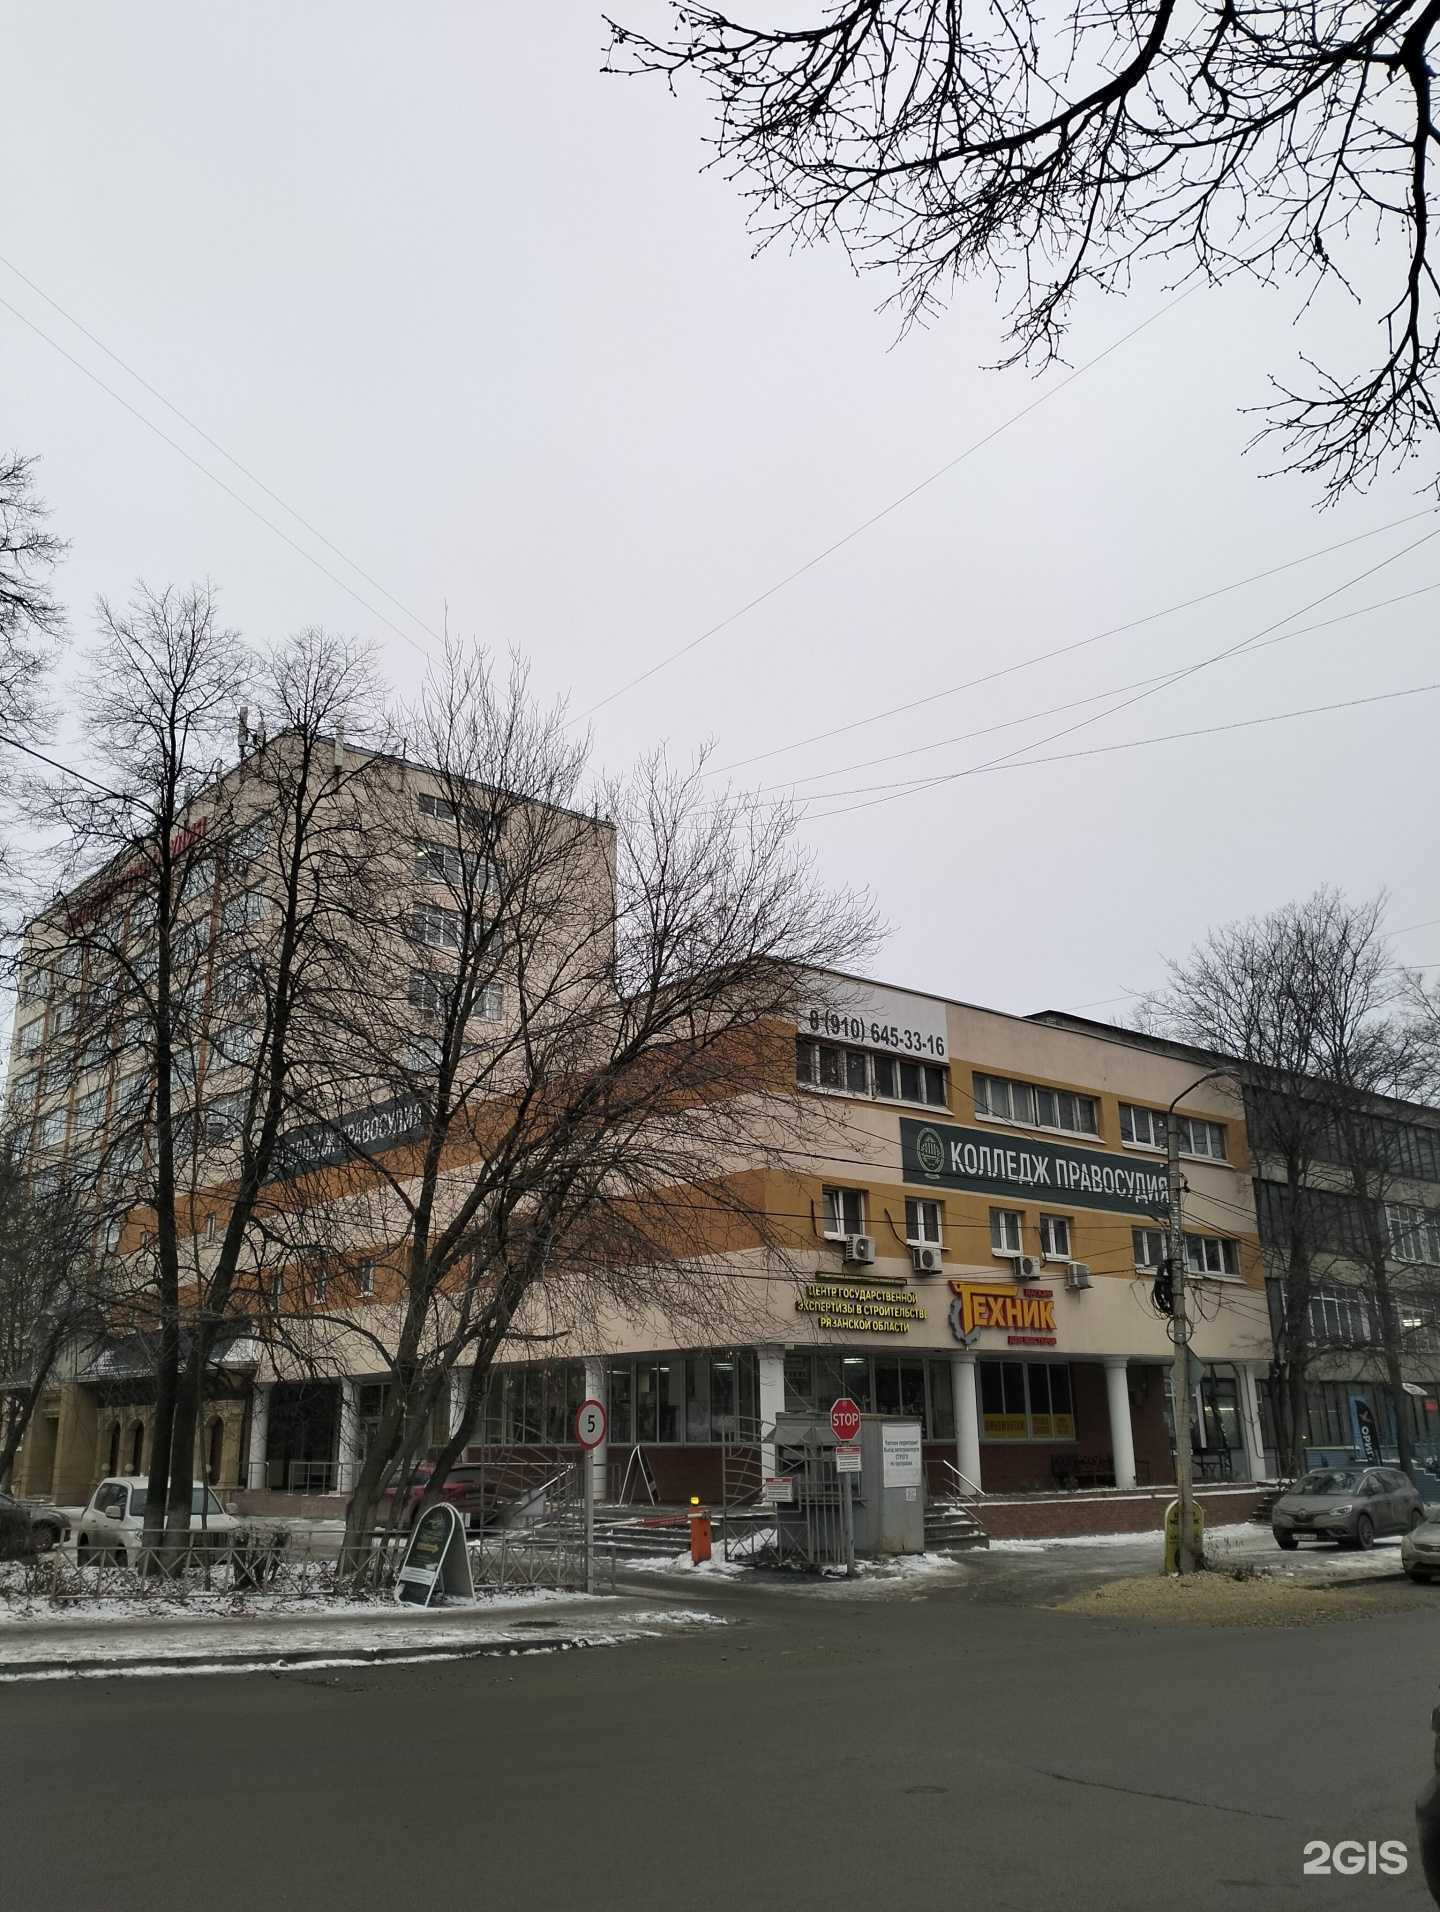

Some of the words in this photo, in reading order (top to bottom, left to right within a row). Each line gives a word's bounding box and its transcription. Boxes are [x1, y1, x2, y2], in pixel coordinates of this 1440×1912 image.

[809, 1009, 819, 1032] 8
[825, 1009, 865, 1042] (910)
[870, 1023, 945, 1057] 645-33-16
[950, 1141, 1051, 1187] КОЛЛЕДЖ
[1055, 1158, 1170, 1204] ПРАВОСУДИЯ
[808, 1285, 837, 1298] ЦЕНТР
[838, 1287, 917, 1304] ГОСУДАРСТВЕННОЙ
[798, 1301, 855, 1314] ЭКСПЕРТИЗЫ
[856, 1304, 862, 1315] В
[863, 1304, 928, 1320] СТРОИТЕЛЬСТВЕ
[949, 1280, 1057, 1335] ТЕХНИК
[820, 1317, 871, 1330] РЯЗАНСКОЙ
[872, 1320, 910, 1333] ОБЛАСТИ
[587, 1414, 596, 1433] 5
[833, 1413, 859, 1427] STOP
